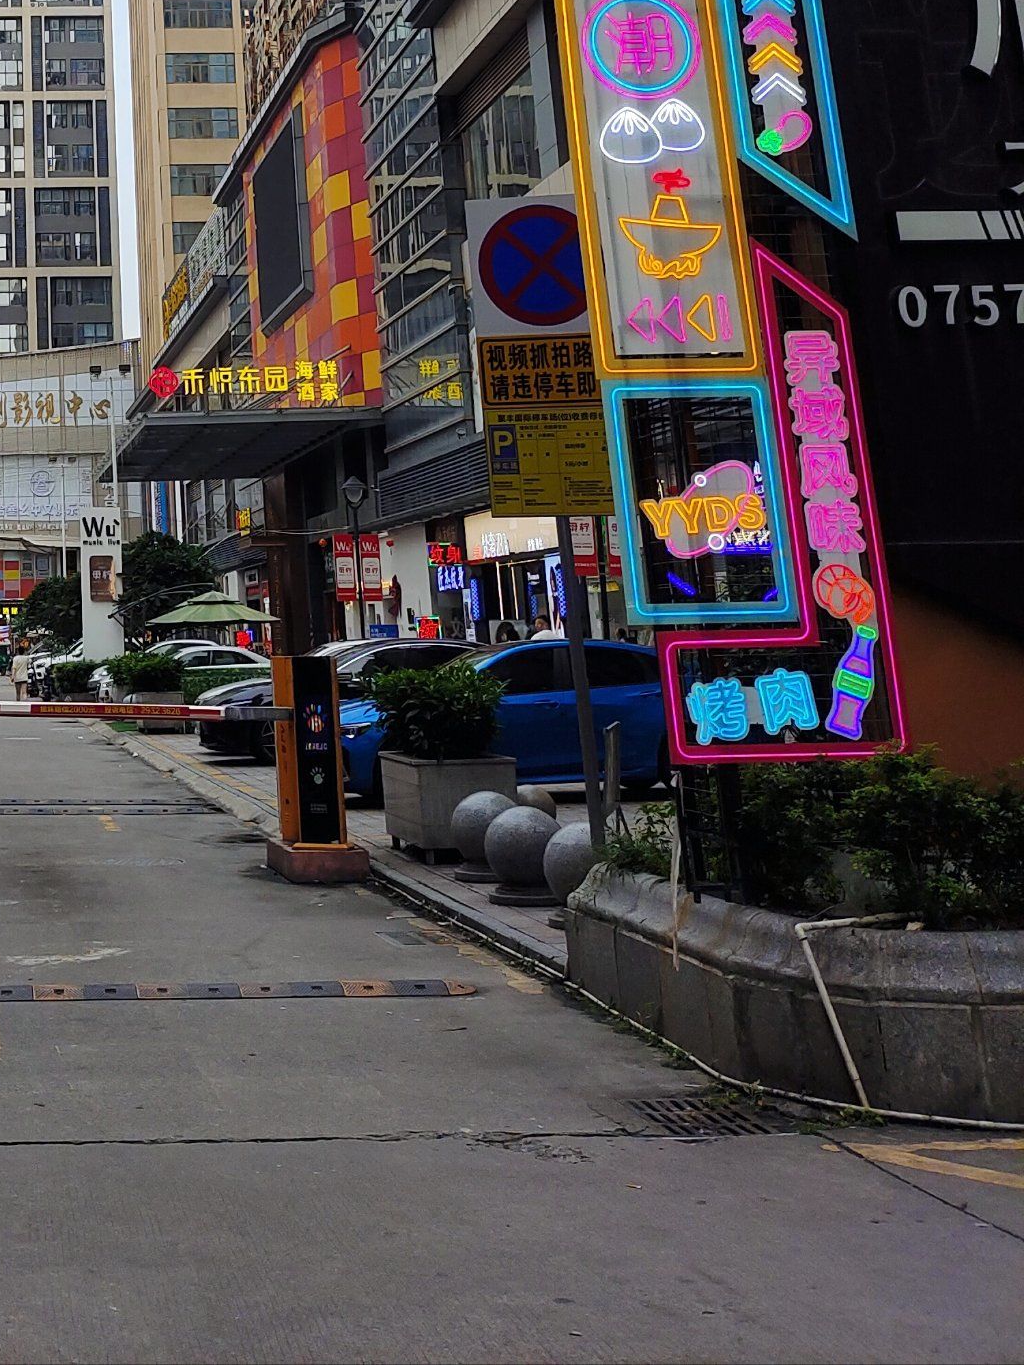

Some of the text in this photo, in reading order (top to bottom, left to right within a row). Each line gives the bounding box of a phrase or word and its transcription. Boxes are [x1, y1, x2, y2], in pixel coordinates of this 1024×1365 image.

[604, 11, 675, 75] 潮
[295, 360, 338, 380] 海鲜
[296, 382, 339, 402] 酒家
[494, 431, 513, 455] P
[784, 331, 866, 554] 异域风味
[640, 494, 767, 539] YYDS
[686, 668, 820, 746] 烤肉
